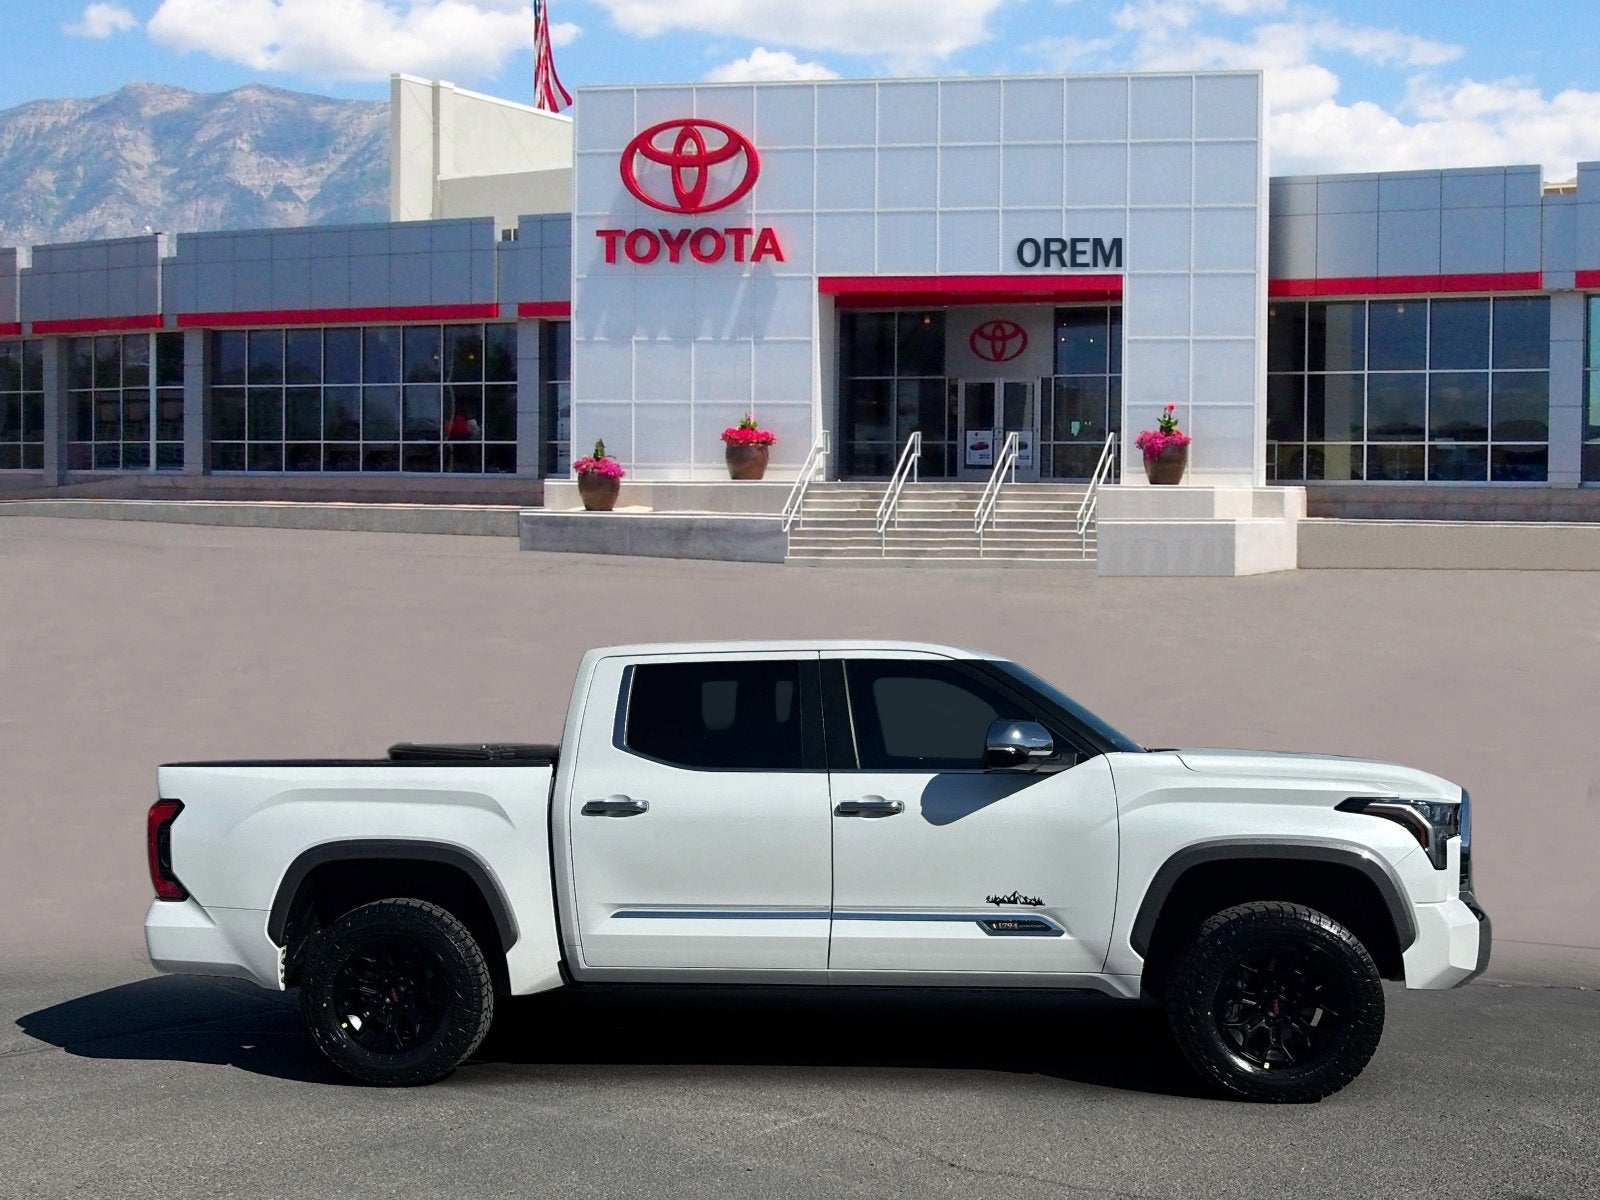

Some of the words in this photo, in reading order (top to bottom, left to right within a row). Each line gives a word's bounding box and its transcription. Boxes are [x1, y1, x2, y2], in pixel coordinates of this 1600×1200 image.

[596, 227, 785, 264] TOYOTA
[1017, 237, 1123, 267] OREM
[998, 922, 1018, 930] 1794
